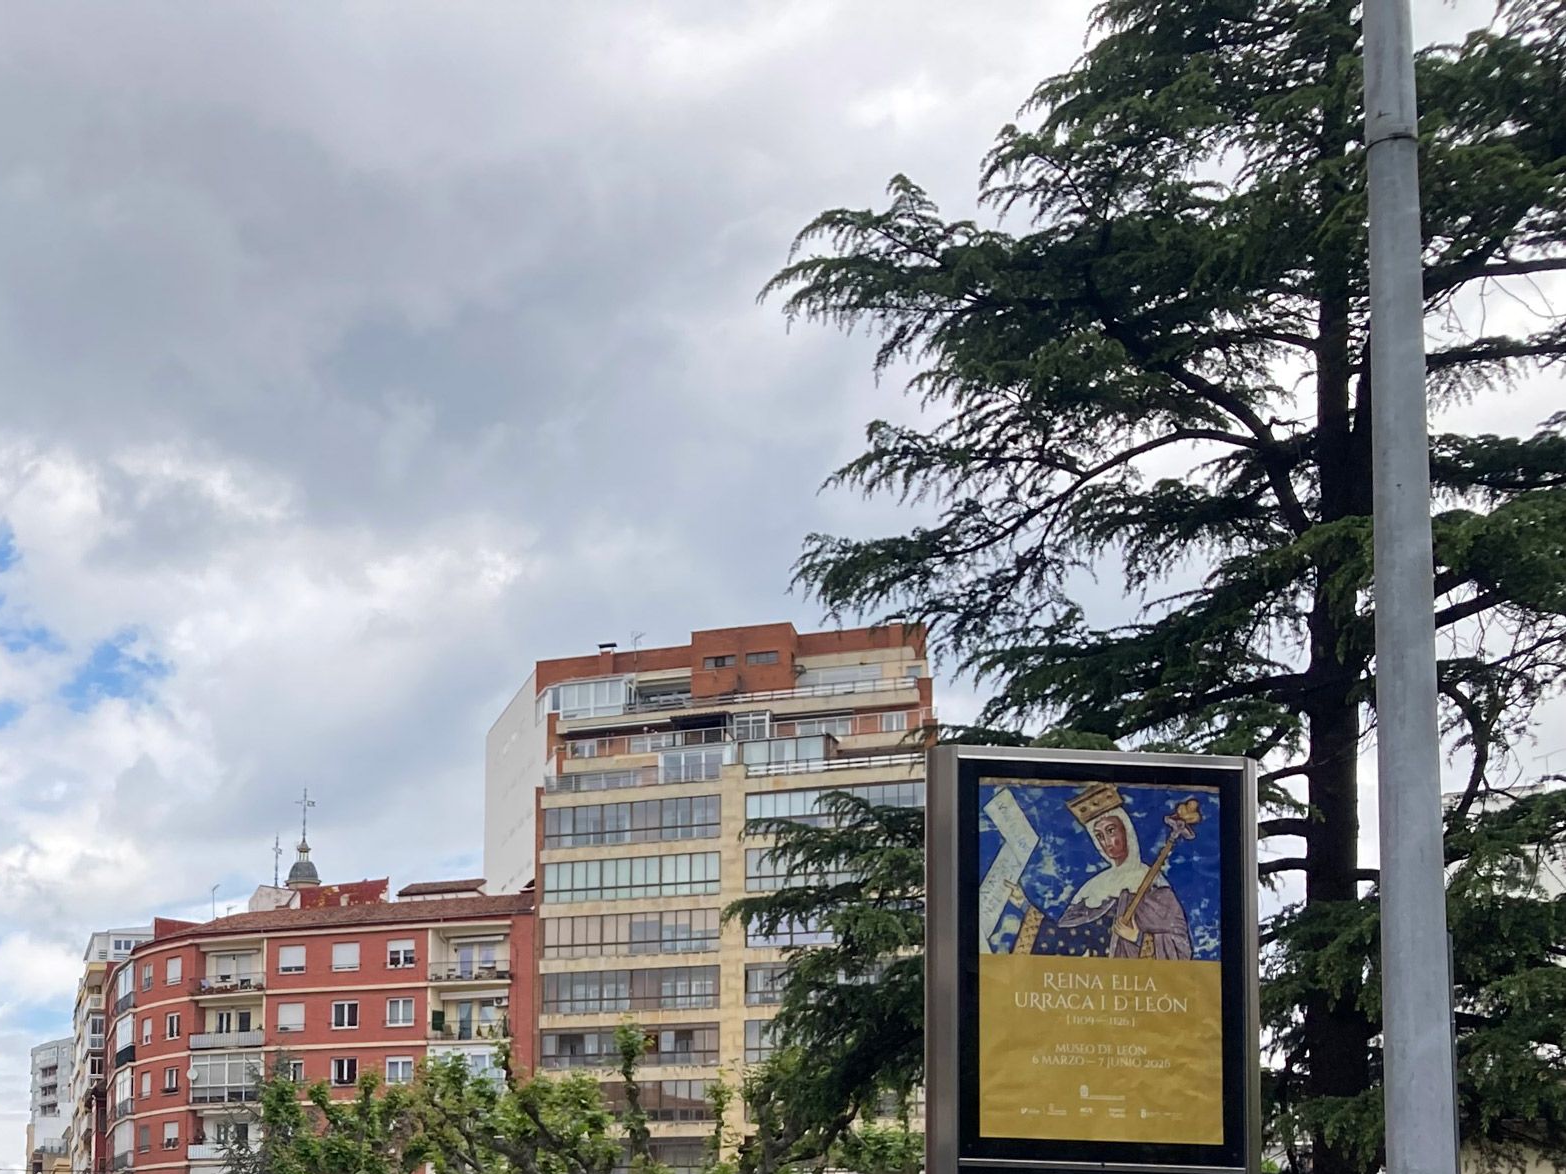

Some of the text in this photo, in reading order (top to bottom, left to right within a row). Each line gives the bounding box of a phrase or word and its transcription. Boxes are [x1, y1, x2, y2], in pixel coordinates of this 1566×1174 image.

[1043, 972, 1157, 992] REINA ELLA
[1014, 991, 1094, 1012] URRACA
[1135, 994, 1188, 1013] LEÓN
[1055, 1043, 1147, 1057] MUSEO DE LEÓN
[1042, 1055, 1084, 1066] MARZO
[1106, 1057, 1141, 1069] JUNIO
